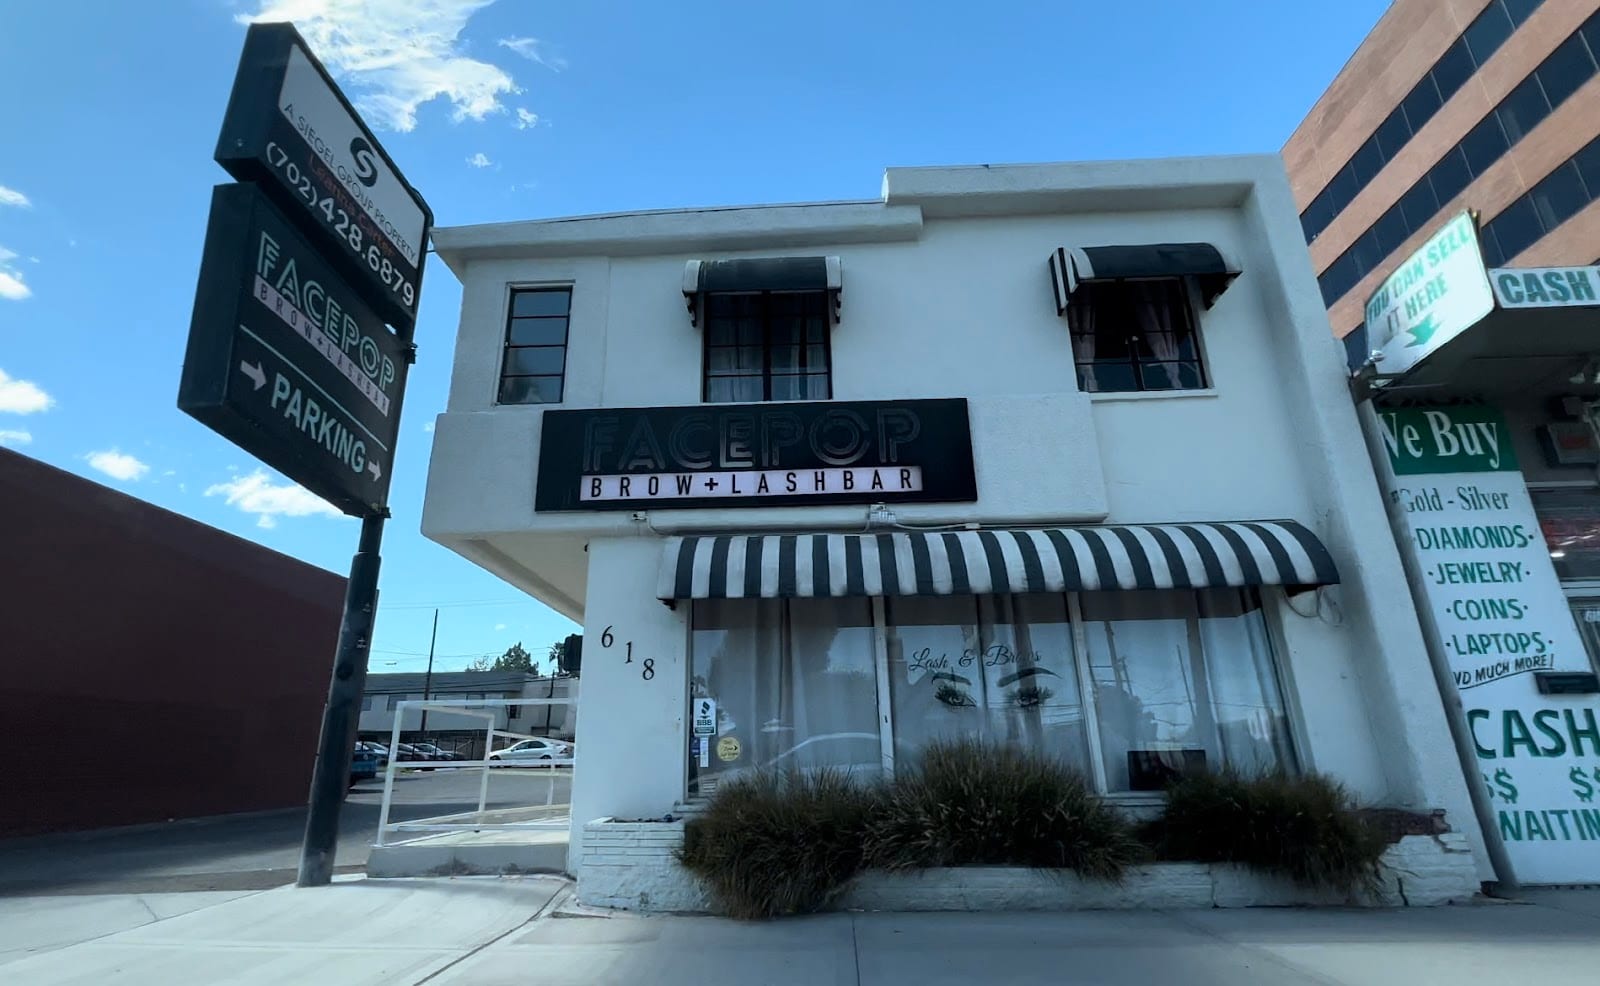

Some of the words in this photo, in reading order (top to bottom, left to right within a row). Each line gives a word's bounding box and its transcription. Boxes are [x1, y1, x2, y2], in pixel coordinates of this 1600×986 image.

[284, 103, 294, 118] A
[298, 116, 335, 168] SIEGEL
[337, 166, 374, 211] GROUP
[375, 209, 416, 261] PROPERTY
[1368, 287, 1390, 323] YOU
[1392, 257, 1425, 298] CAN
[1427, 223, 1471, 264] SELL
[1386, 306, 1402, 333] IT
[1404, 272, 1448, 320] HERE
[1498, 271, 1593, 304] CASH
[257, 231, 395, 391] FACEPOP
[270, 372, 367, 473] PARKING
[582, 407, 921, 472] FACEPOP
[1423, 410, 1500, 469] Buy
[1456, 486, 1510, 511] Silver
[908, 647, 949, 671] Lash
[958, 648, 976, 667] &
[984, 645, 1042, 667] Bros
[1453, 671, 1472, 686] ND
[1475, 661, 1510, 682] MUCH
[1467, 708, 1600, 759] CASH
[1498, 809, 1600, 841] WAITIN
